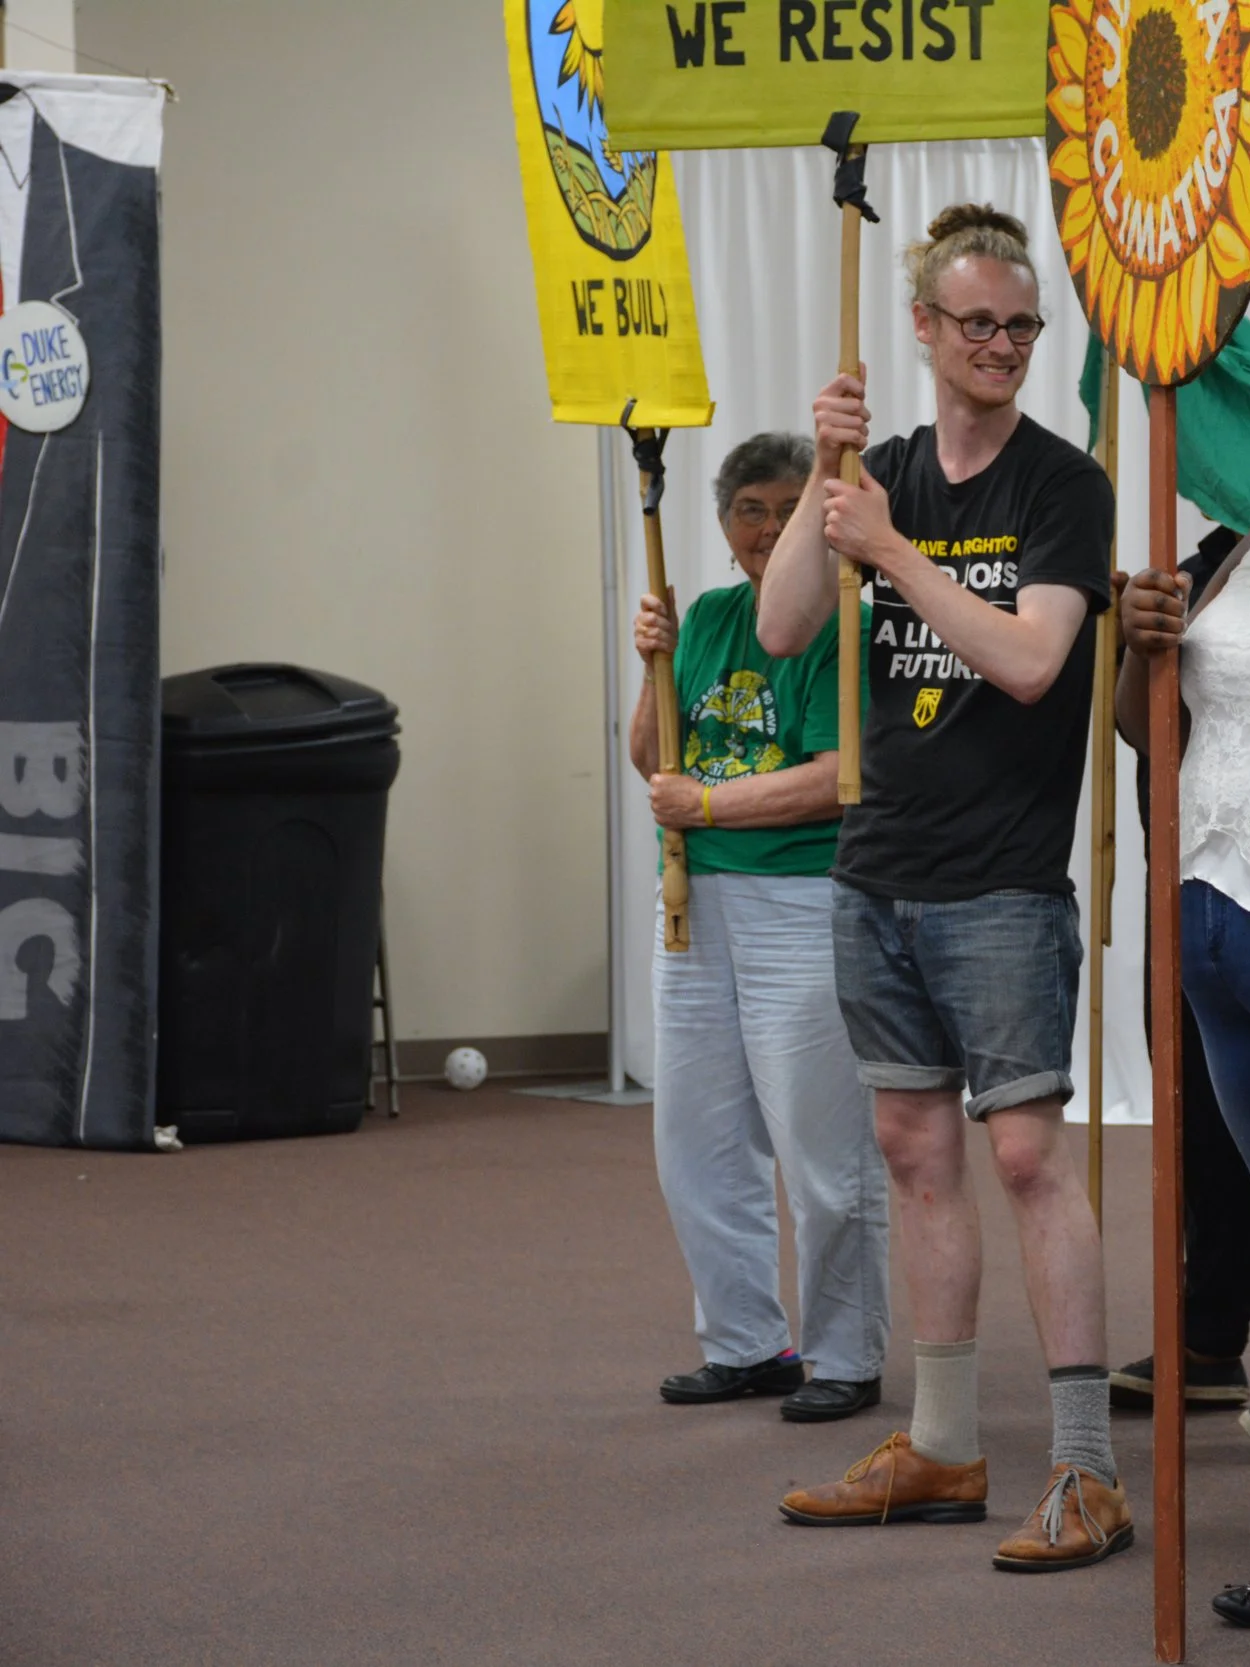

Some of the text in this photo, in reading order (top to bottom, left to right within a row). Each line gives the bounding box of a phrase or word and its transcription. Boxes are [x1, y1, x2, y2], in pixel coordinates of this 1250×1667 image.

[665, 0, 994, 68] WE RESIST
[571, 279, 604, 336] WE
[21, 325, 71, 367] DUKE
[29, 363, 84, 407] ENERGY
[911, 539, 949, 557] AVE
[961, 561, 1019, 590] JOBS
[874, 619, 898, 647] A
[889, 652, 984, 680] FUTUR
[765, 708, 777, 736] MVP
